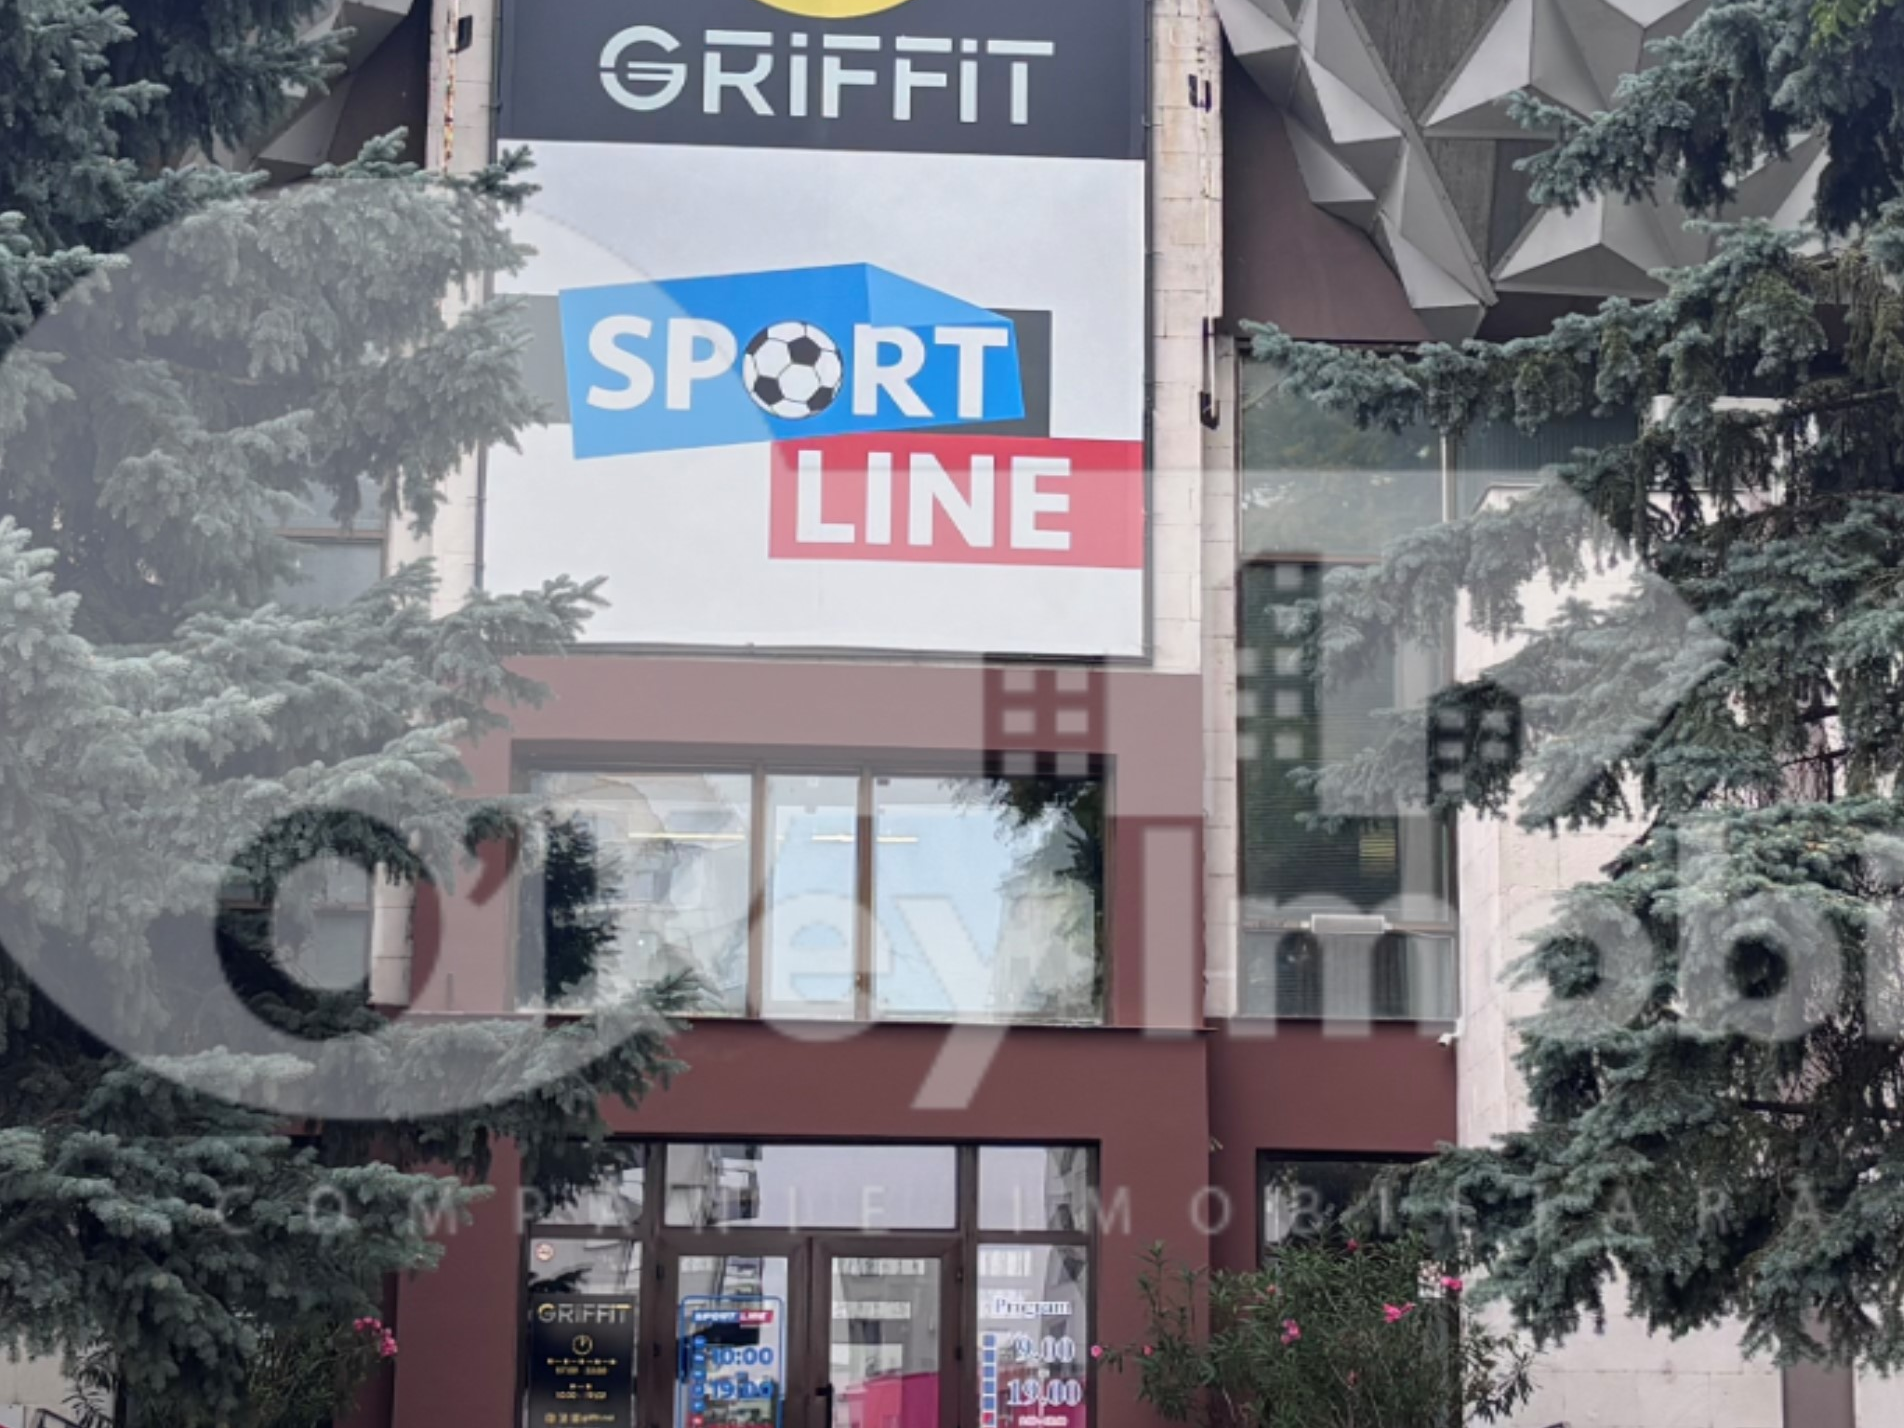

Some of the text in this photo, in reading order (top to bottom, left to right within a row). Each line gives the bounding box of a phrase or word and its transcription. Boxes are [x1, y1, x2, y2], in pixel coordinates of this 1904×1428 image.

[795, 448, 1071, 552] LINE
[995, 1298, 1071, 1317] Program
[711, 1347, 774, 1365] 10:00
